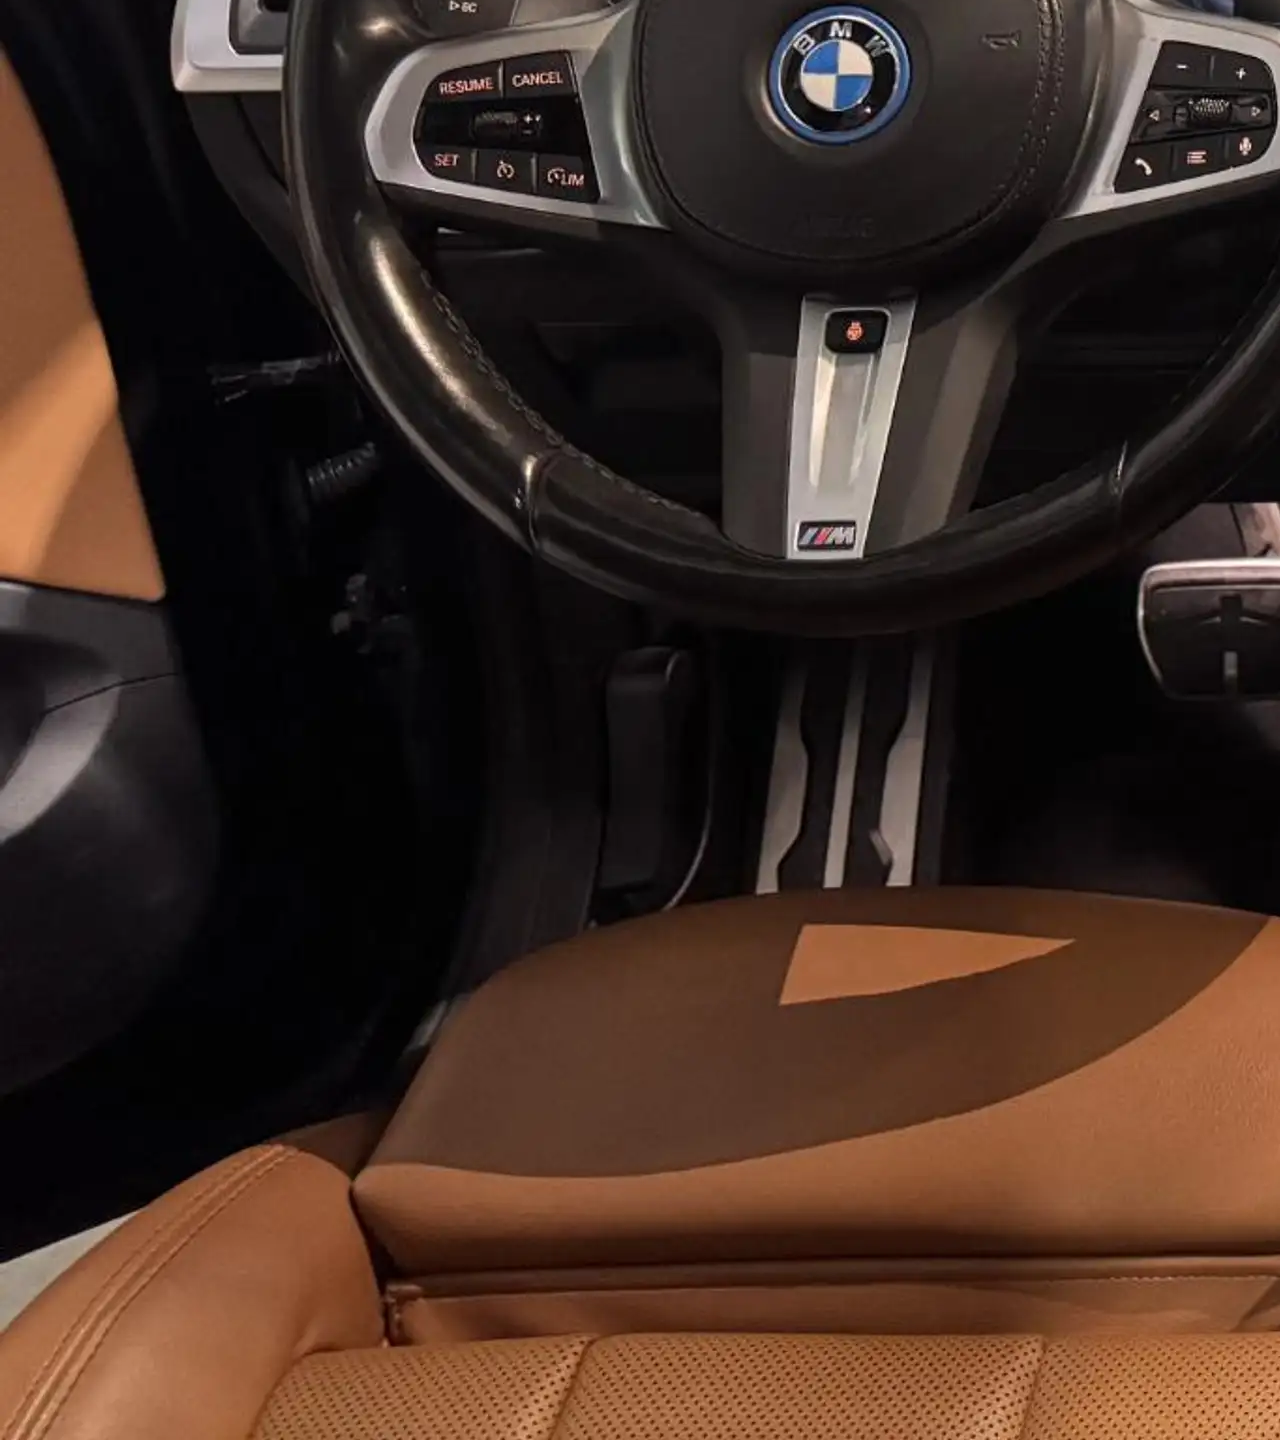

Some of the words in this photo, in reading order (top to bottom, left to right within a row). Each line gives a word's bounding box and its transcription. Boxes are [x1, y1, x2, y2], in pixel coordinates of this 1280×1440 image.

[793, 20, 892, 59] BMW
[439, 76, 494, 95] RESUME
[511, 70, 564, 88] CANCEL
[435, 153, 460, 167] SET
[562, 175, 584, 187] LIM
